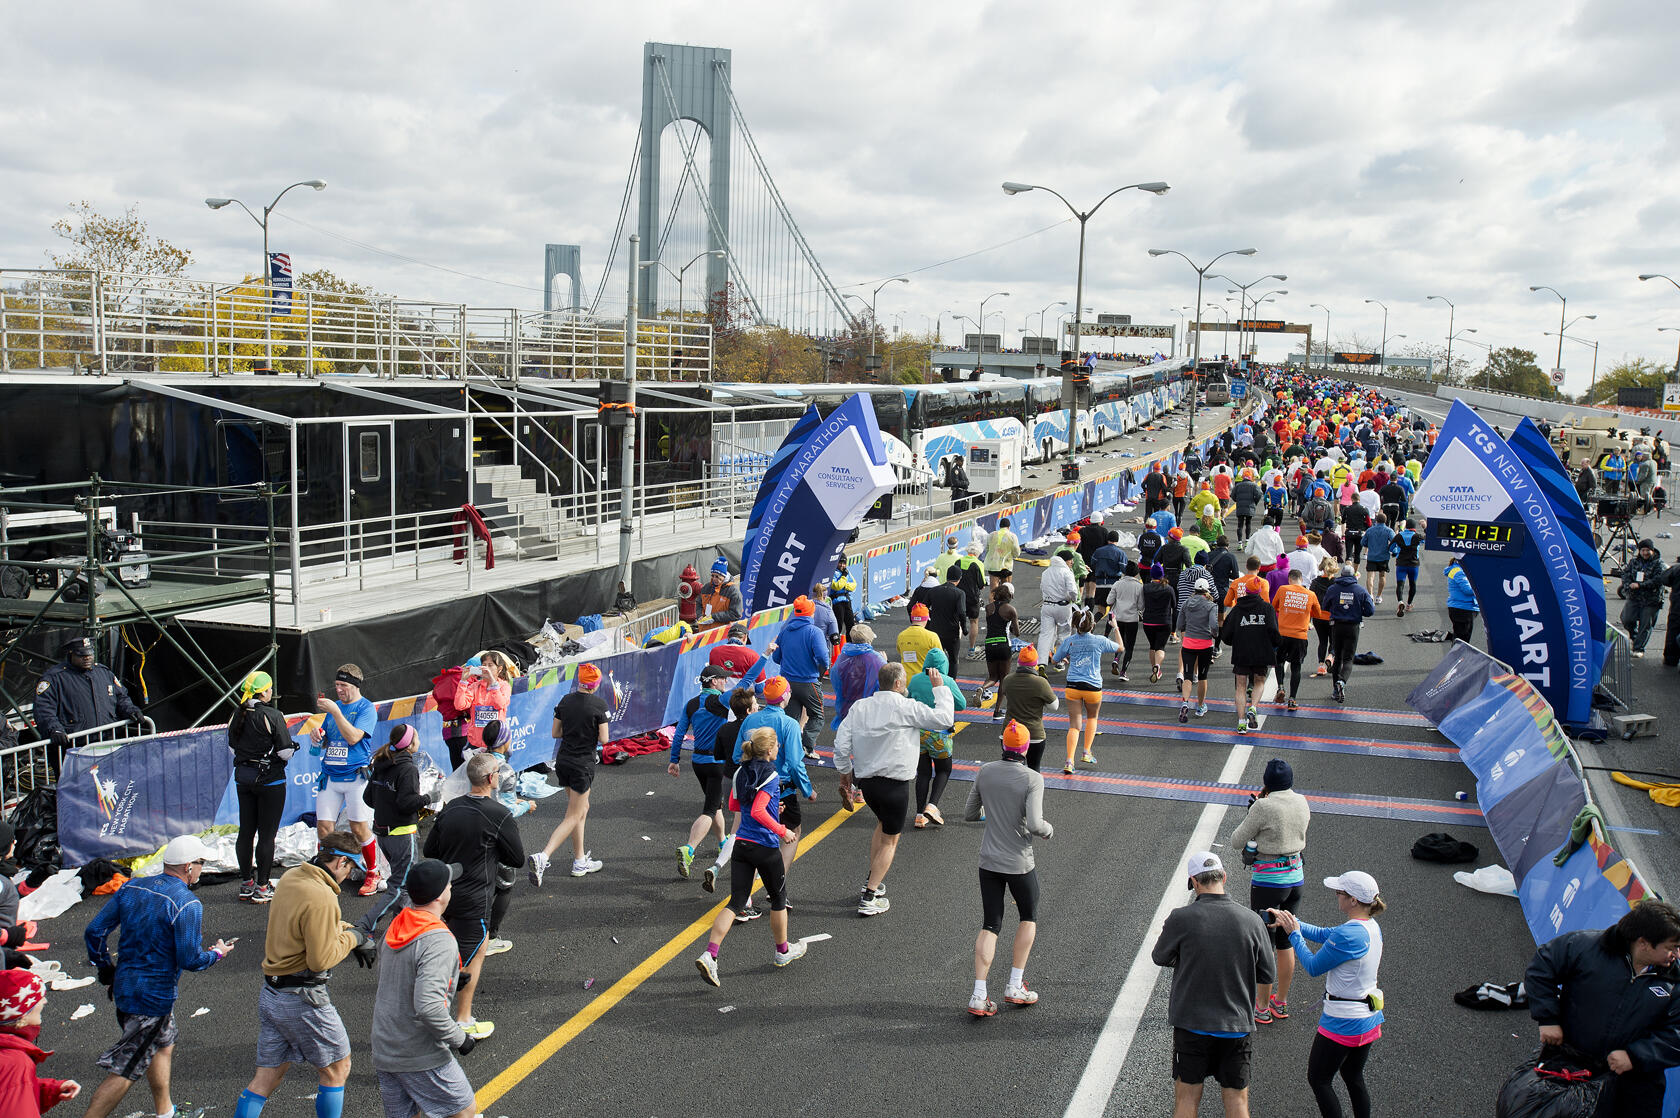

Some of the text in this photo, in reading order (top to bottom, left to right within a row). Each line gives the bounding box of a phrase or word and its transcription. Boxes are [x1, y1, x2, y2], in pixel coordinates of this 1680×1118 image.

[817, 472, 864, 483] CONSULTANCY
[831, 466, 850, 475] TATA
[825, 481, 855, 490] SERVICES
[1429, 494, 1492, 503] CONSULTANCY
[746, 560, 761, 594] NEW
[756, 516, 778, 555] YORK
[773, 482, 793, 514] CITY
[790, 412, 849, 481] MARATHON
[1440, 503, 1481, 511] SERVICES
[767, 531, 806, 608] TART
[1467, 424, 1587, 689] TCS NEW YORK CITY MARATHON
[1502, 574, 1552, 688] START
[109, 780, 136, 836] NEW YORK CITY
[118, 792, 139, 834] MARATHON
[100, 822, 110, 838] TCS
